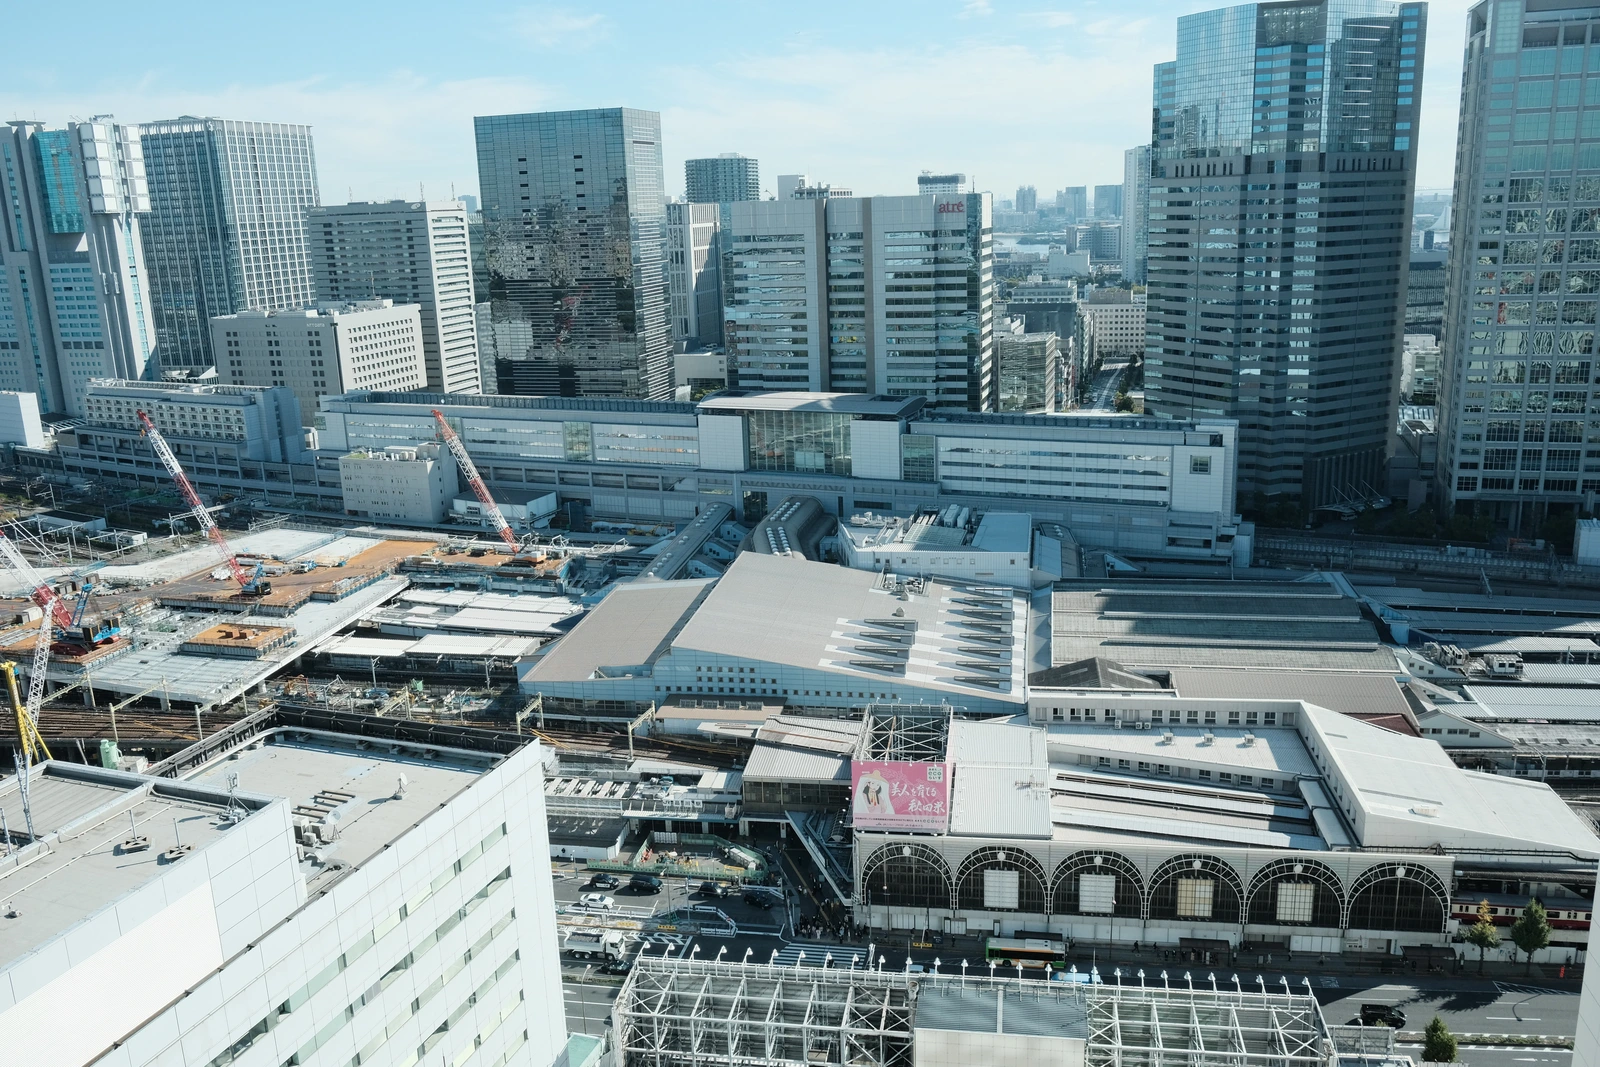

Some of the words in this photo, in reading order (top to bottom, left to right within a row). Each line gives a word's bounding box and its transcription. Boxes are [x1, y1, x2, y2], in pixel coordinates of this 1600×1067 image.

[938, 200, 965, 213] atré
[891, 781, 937, 798] 美人を育てる
[908, 799, 945, 814] 秋田米
